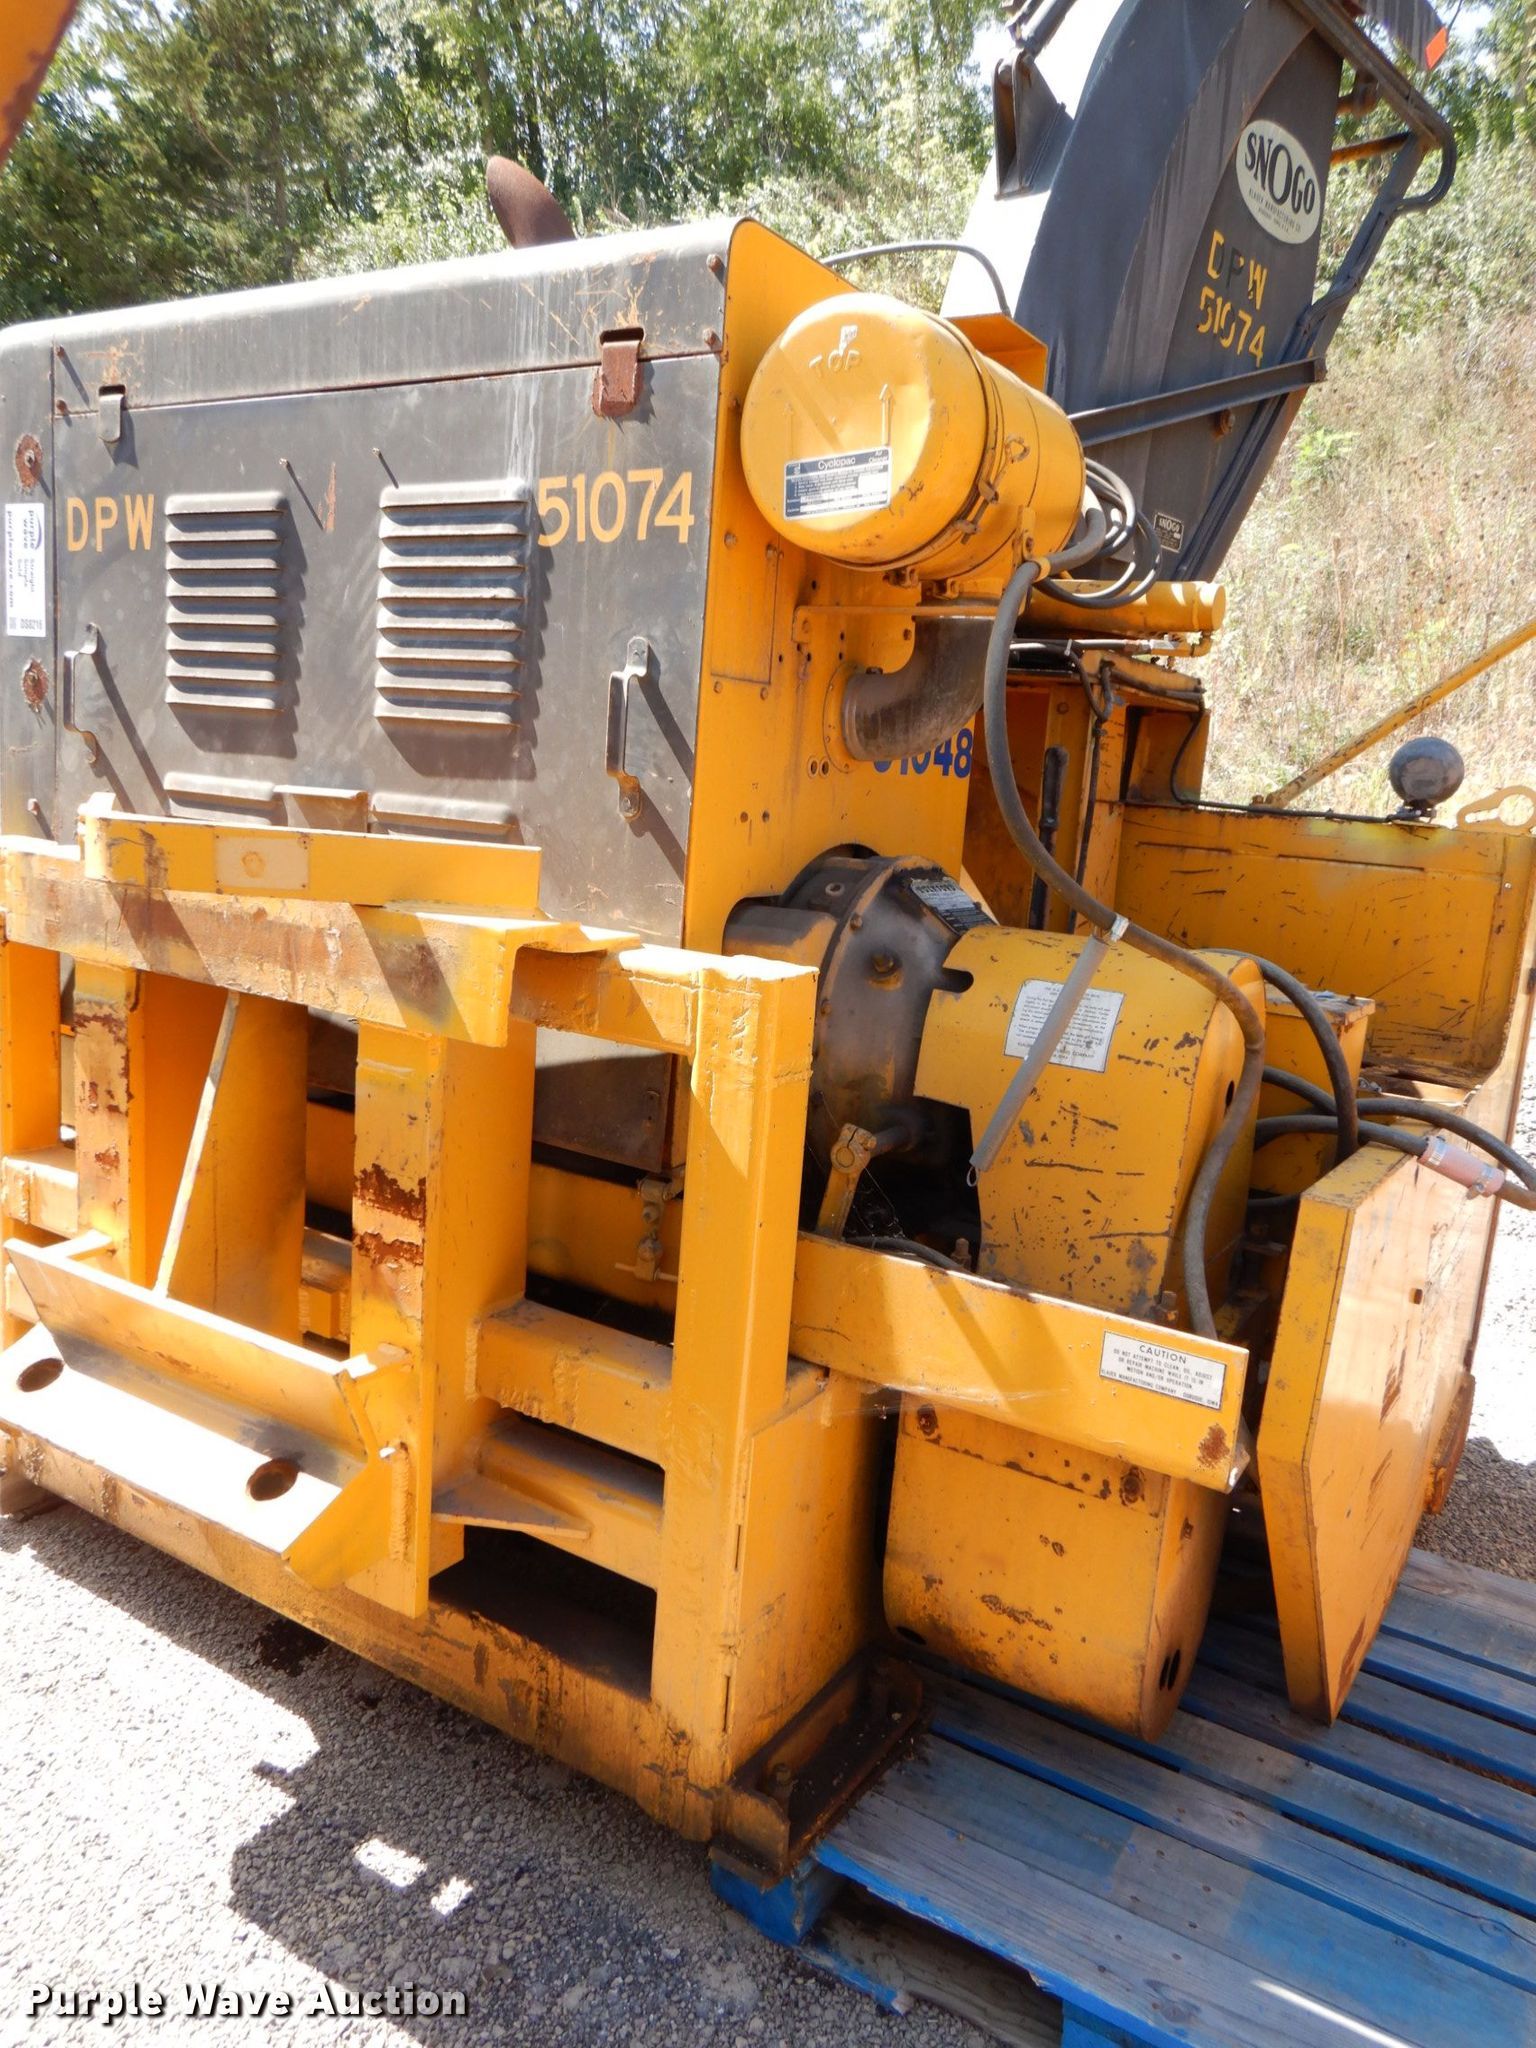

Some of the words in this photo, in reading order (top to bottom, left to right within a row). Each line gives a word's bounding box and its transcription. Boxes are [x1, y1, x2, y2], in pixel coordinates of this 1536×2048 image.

[1244, 131, 1316, 215] SNOGO
[1196, 286, 1266, 368] 51074
[818, 457, 856, 471] Cyclopac
[66, 494, 155, 552] DPW
[537, 468, 695, 547] 51074
[1139, 1345, 1186, 1364] CAUTION
